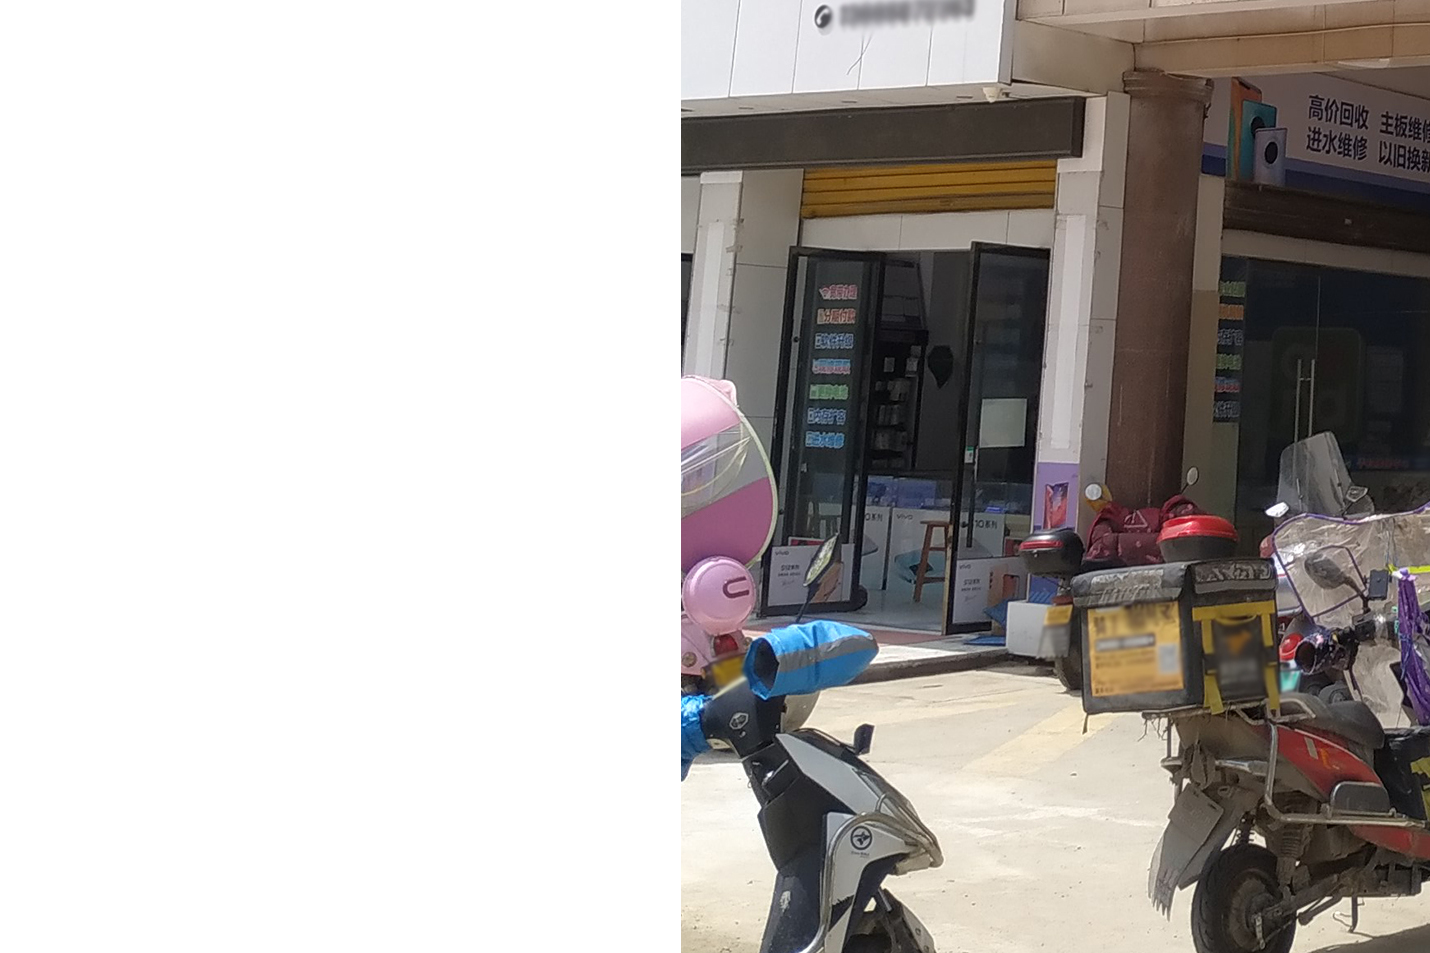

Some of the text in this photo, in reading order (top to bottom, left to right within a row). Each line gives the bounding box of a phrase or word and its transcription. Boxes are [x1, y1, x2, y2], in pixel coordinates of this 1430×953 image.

[1308, 94, 1370, 131] 高价回收
[1305, 126, 1368, 161] 进水维修
